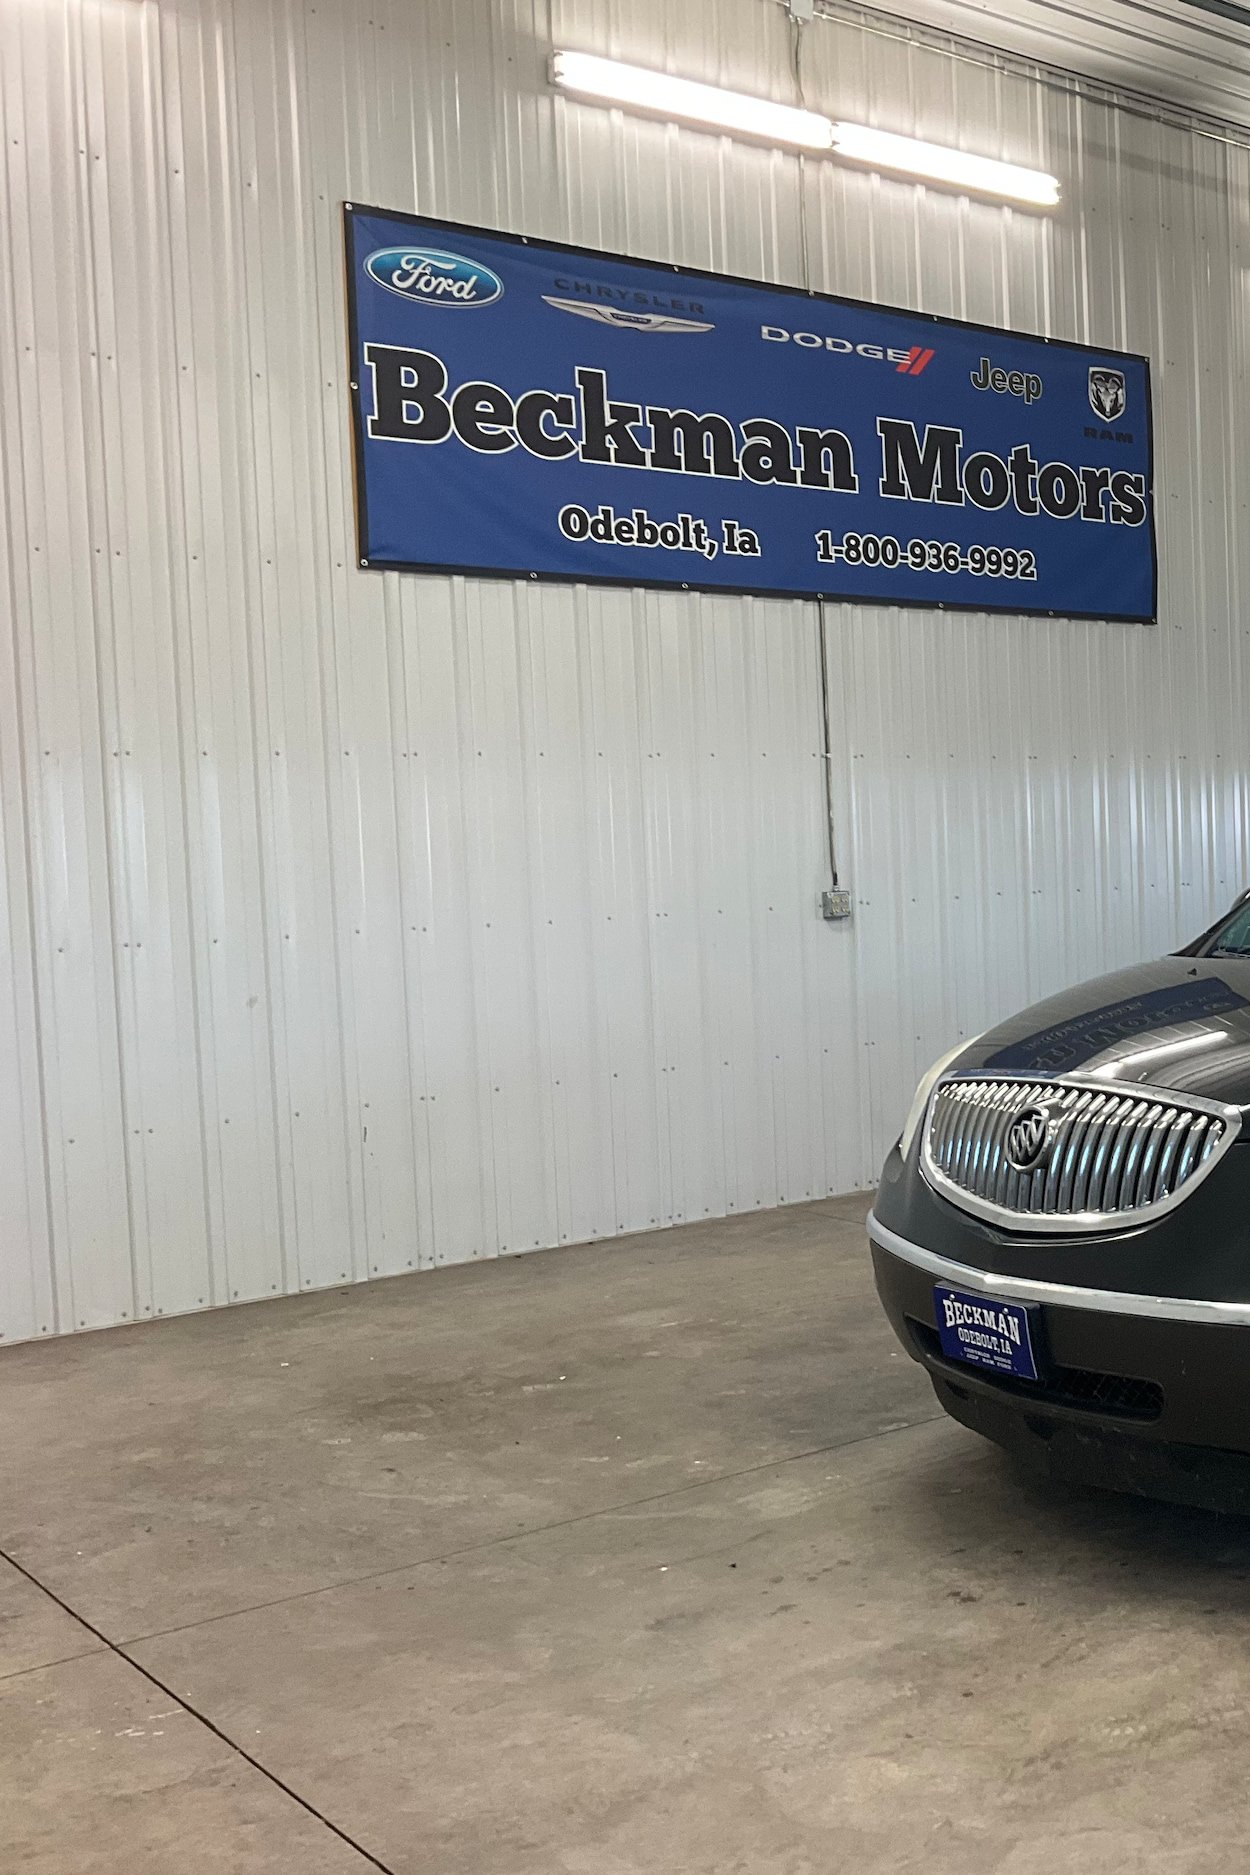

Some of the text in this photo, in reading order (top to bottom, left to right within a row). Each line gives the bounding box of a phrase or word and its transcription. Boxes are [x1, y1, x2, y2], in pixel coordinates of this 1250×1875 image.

[391, 255, 477, 300] Ford
[553, 277, 705, 314] CHRYSLER
[760, 325, 911, 364] DODGE
[970, 357, 1043, 404] Jeep
[364, 342, 1147, 527] Beckman Motors
[1083, 426, 1134, 444] RAM
[557, 503, 761, 561] Odebolt, Ia
[815, 528, 1038, 581] 1-800-936-9992
[942, 1299, 1021, 1346] BECKMAN
